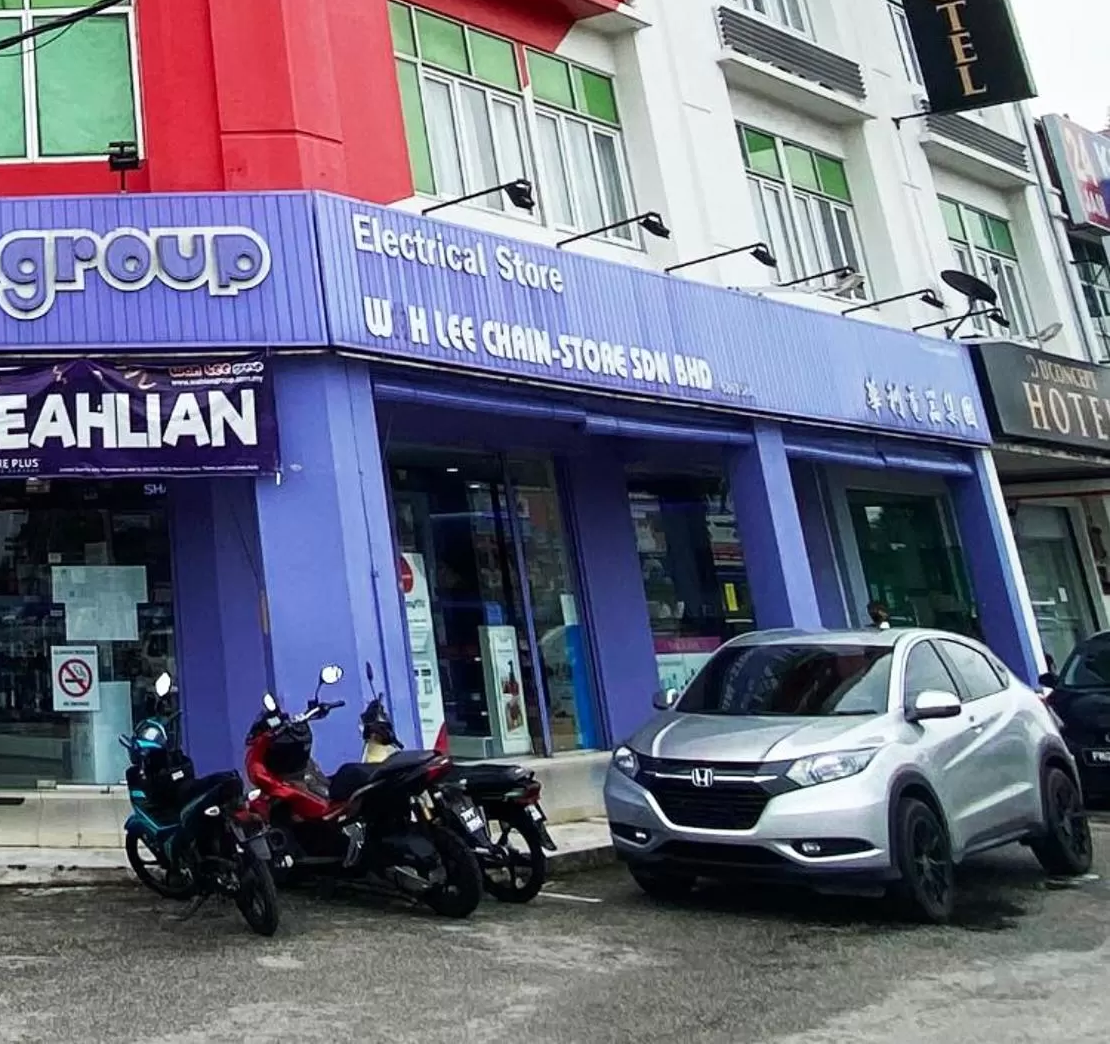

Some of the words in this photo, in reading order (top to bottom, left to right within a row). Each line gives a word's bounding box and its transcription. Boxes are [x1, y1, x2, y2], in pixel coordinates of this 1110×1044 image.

[352, 213, 487, 278] Electrical
[495, 245, 564, 294] Store
[433, 309, 477, 354] LEE
[482, 319, 629, 379] CHAIN-STORE
[629, 347, 672, 386] SDN
[674, 355, 714, 391] BHD
[11, 457, 40, 468] PLUS
